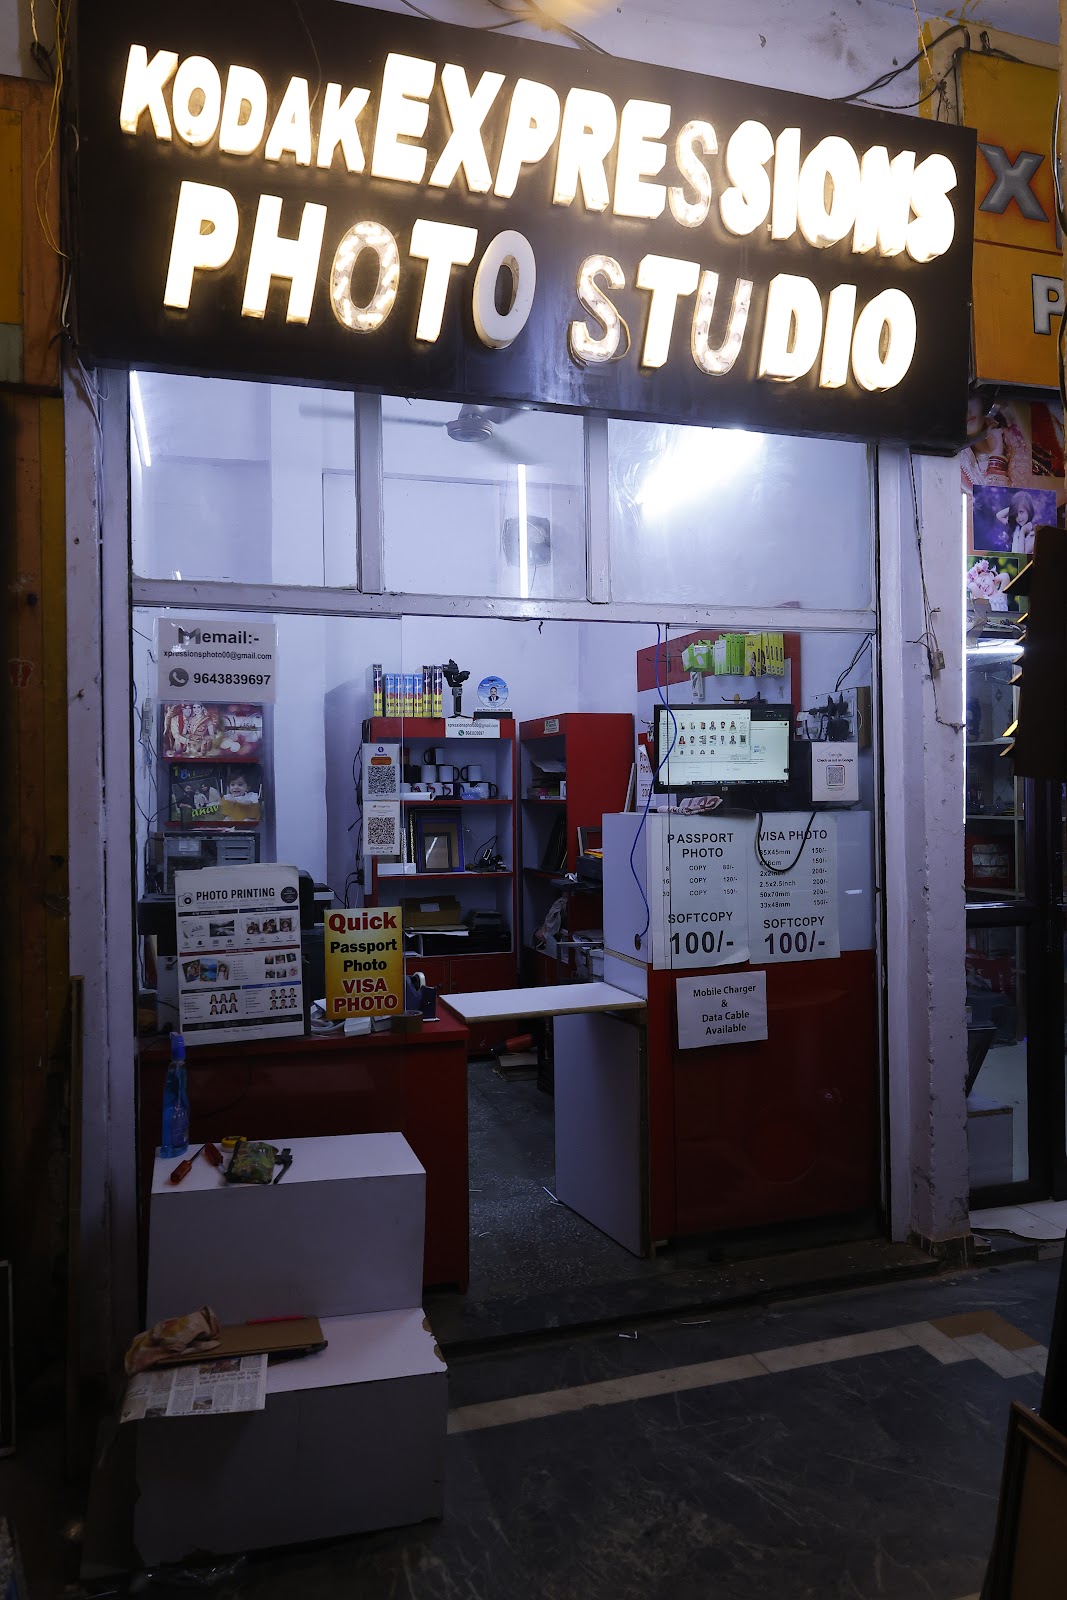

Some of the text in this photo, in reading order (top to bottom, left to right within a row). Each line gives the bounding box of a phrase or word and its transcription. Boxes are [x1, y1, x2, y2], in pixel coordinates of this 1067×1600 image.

[119, 43, 957, 263] KODAK EXPRESSIONS
[164, 181, 917, 392] PHOTO STUDIO
[193, 672, 271, 685] 9643839697
[667, 833, 734, 844] PASSPORT
[759, 829, 828, 841] VISA PHOTO
[682, 847, 724, 858] PHOTO
[196, 890, 228, 901] PHOTO
[231, 887, 275, 899] PRINTING
[328, 912, 397, 934] Quick
[667, 911, 734, 924] SOFTCOPY
[763, 916, 825, 929] SOFTCOPY
[330, 939, 397, 954] Passport
[670, 930, 735, 955] 100/-
[764, 930, 826, 955] 100/-
[343, 959, 387, 972] Photo
[343, 978, 387, 994] VISA
[693, 984, 756, 997] Mobile Charger
[334, 994, 398, 1012] PHOTO
[721, 999, 728, 1007] &
[702, 1010, 750, 1022] Data Cable
[705, 1023, 747, 1035] Available
